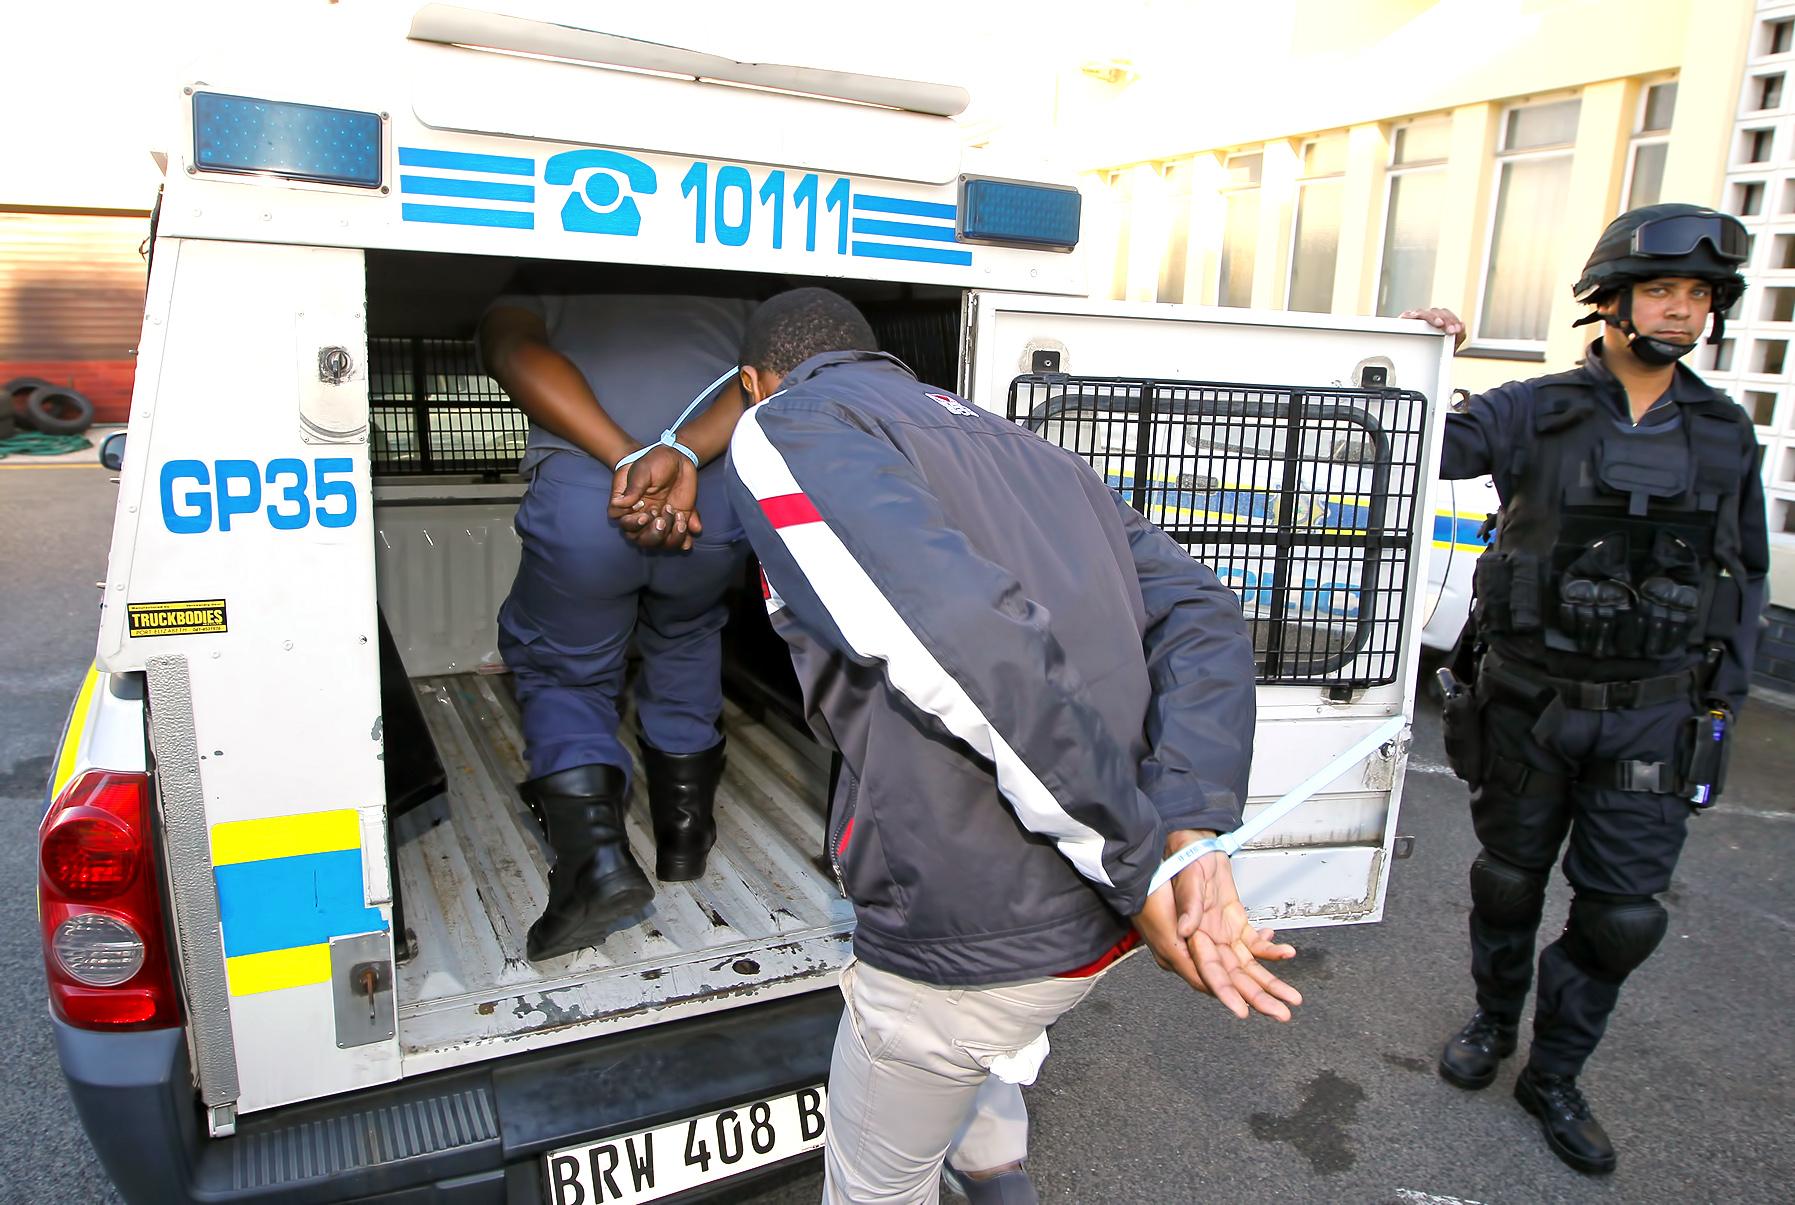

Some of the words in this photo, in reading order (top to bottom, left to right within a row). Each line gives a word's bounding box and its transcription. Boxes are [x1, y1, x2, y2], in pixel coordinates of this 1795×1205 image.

[681, 162, 850, 255] 10111
[160, 458, 357, 534] GP35
[132, 609, 223, 627] TRUCKBODIES
[551, 1132, 655, 1205] BRW
[684, 1101, 776, 1173] 408
[796, 1088, 826, 1142] B
